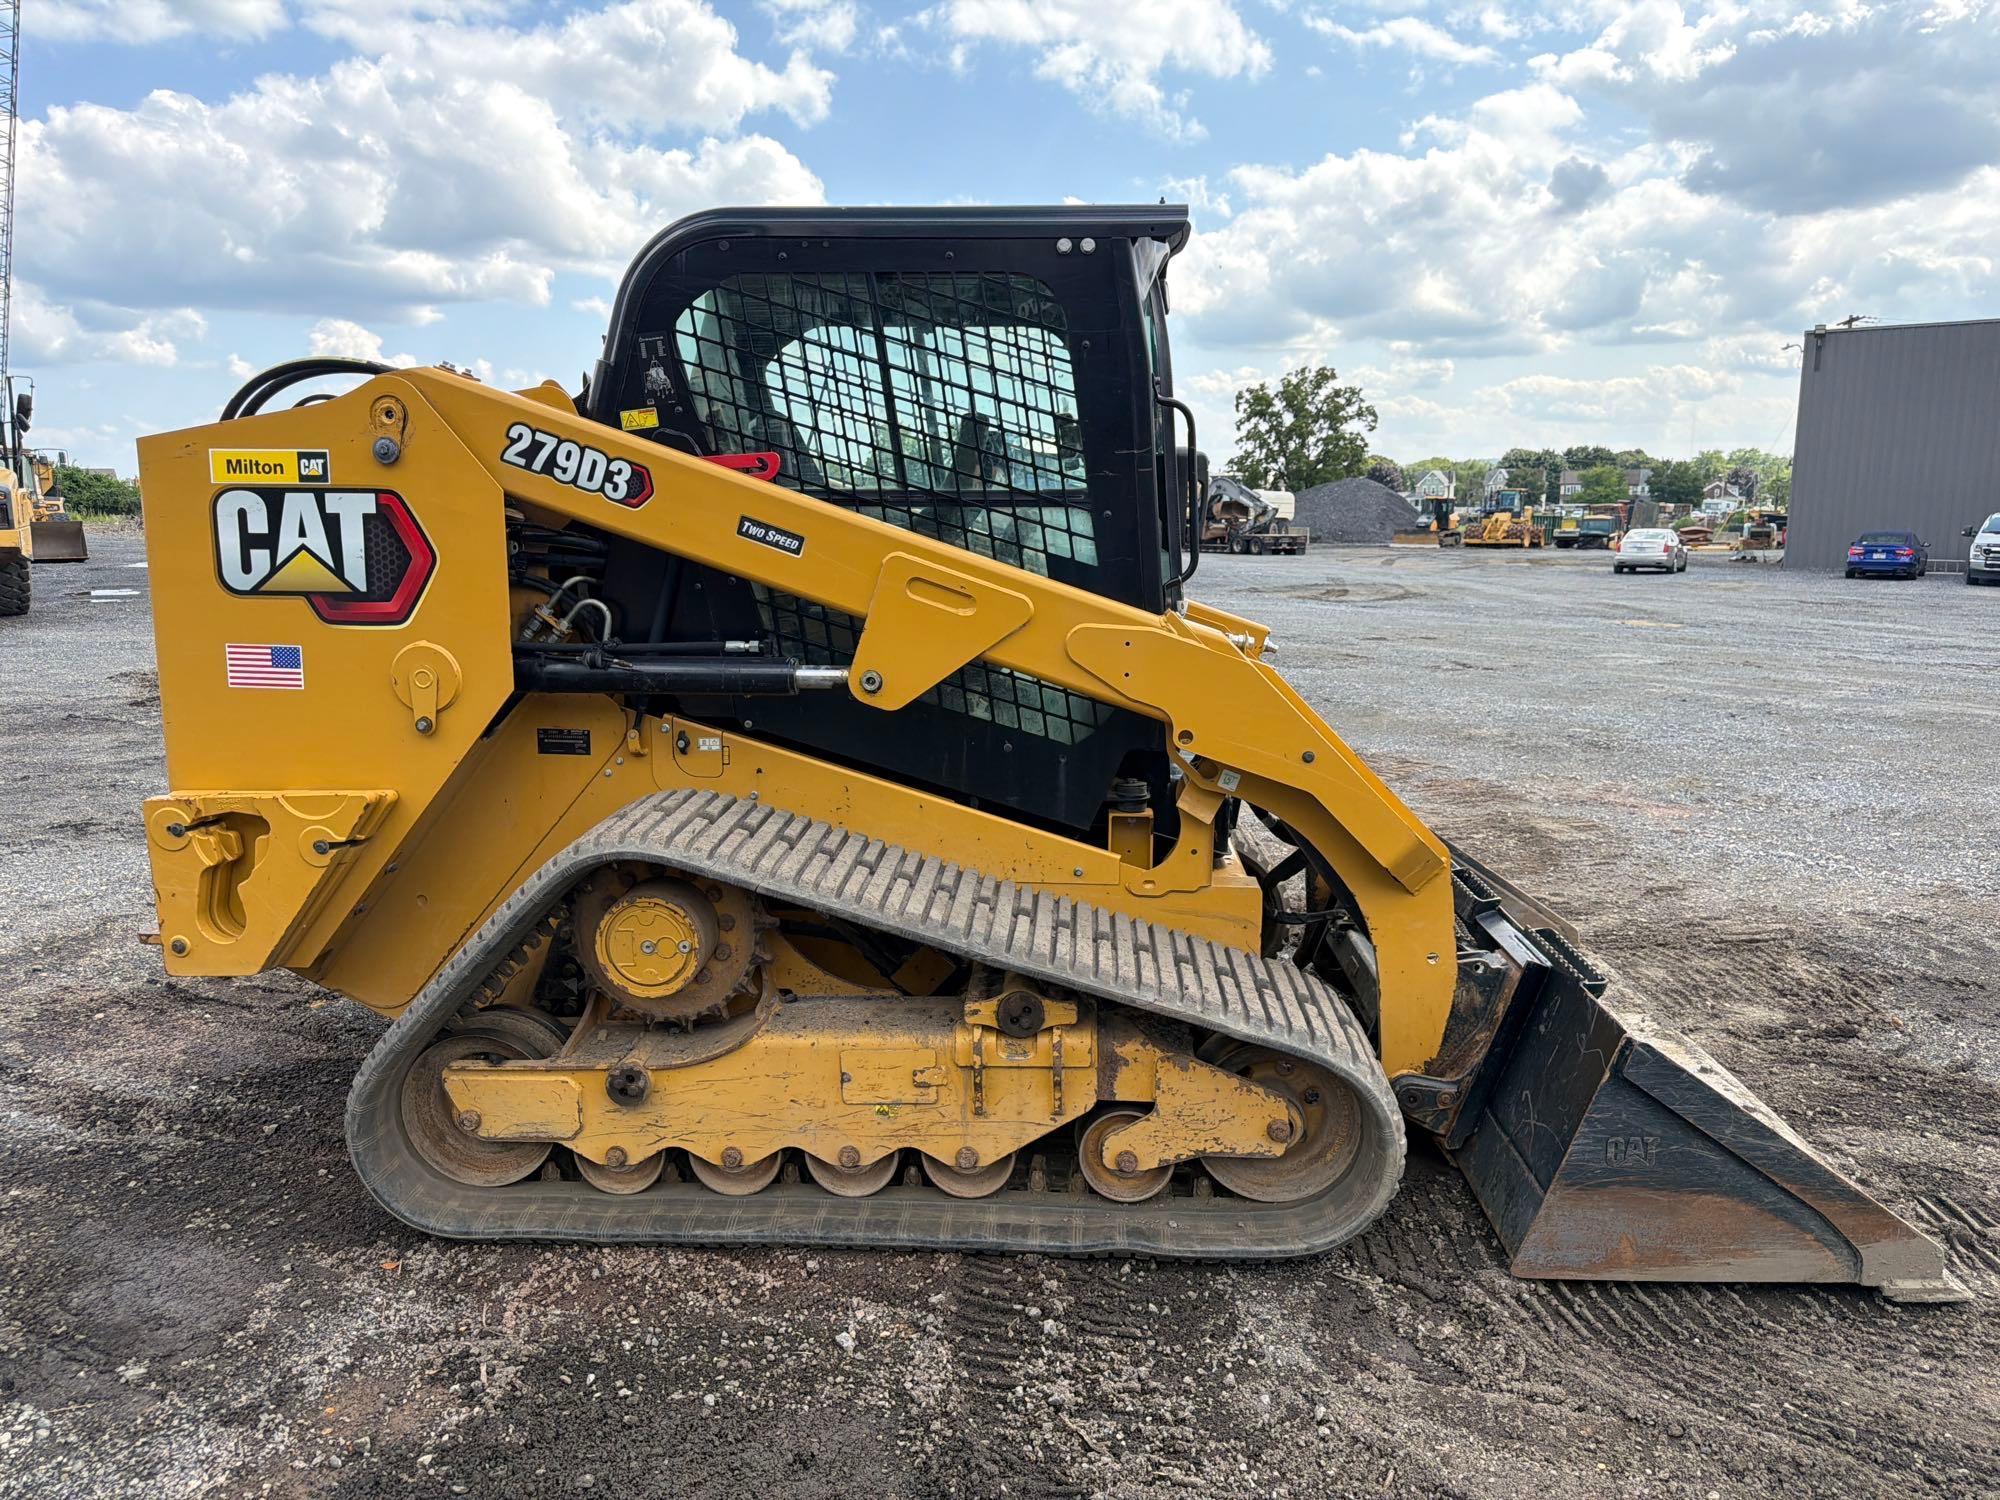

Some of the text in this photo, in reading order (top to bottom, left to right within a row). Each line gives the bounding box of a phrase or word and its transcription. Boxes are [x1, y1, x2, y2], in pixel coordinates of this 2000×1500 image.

[226, 459, 325, 476] Milton CAT
[503, 424, 632, 500] 279D3
[216, 490, 377, 592] CAT
[1606, 1136, 1660, 1168] CAT
